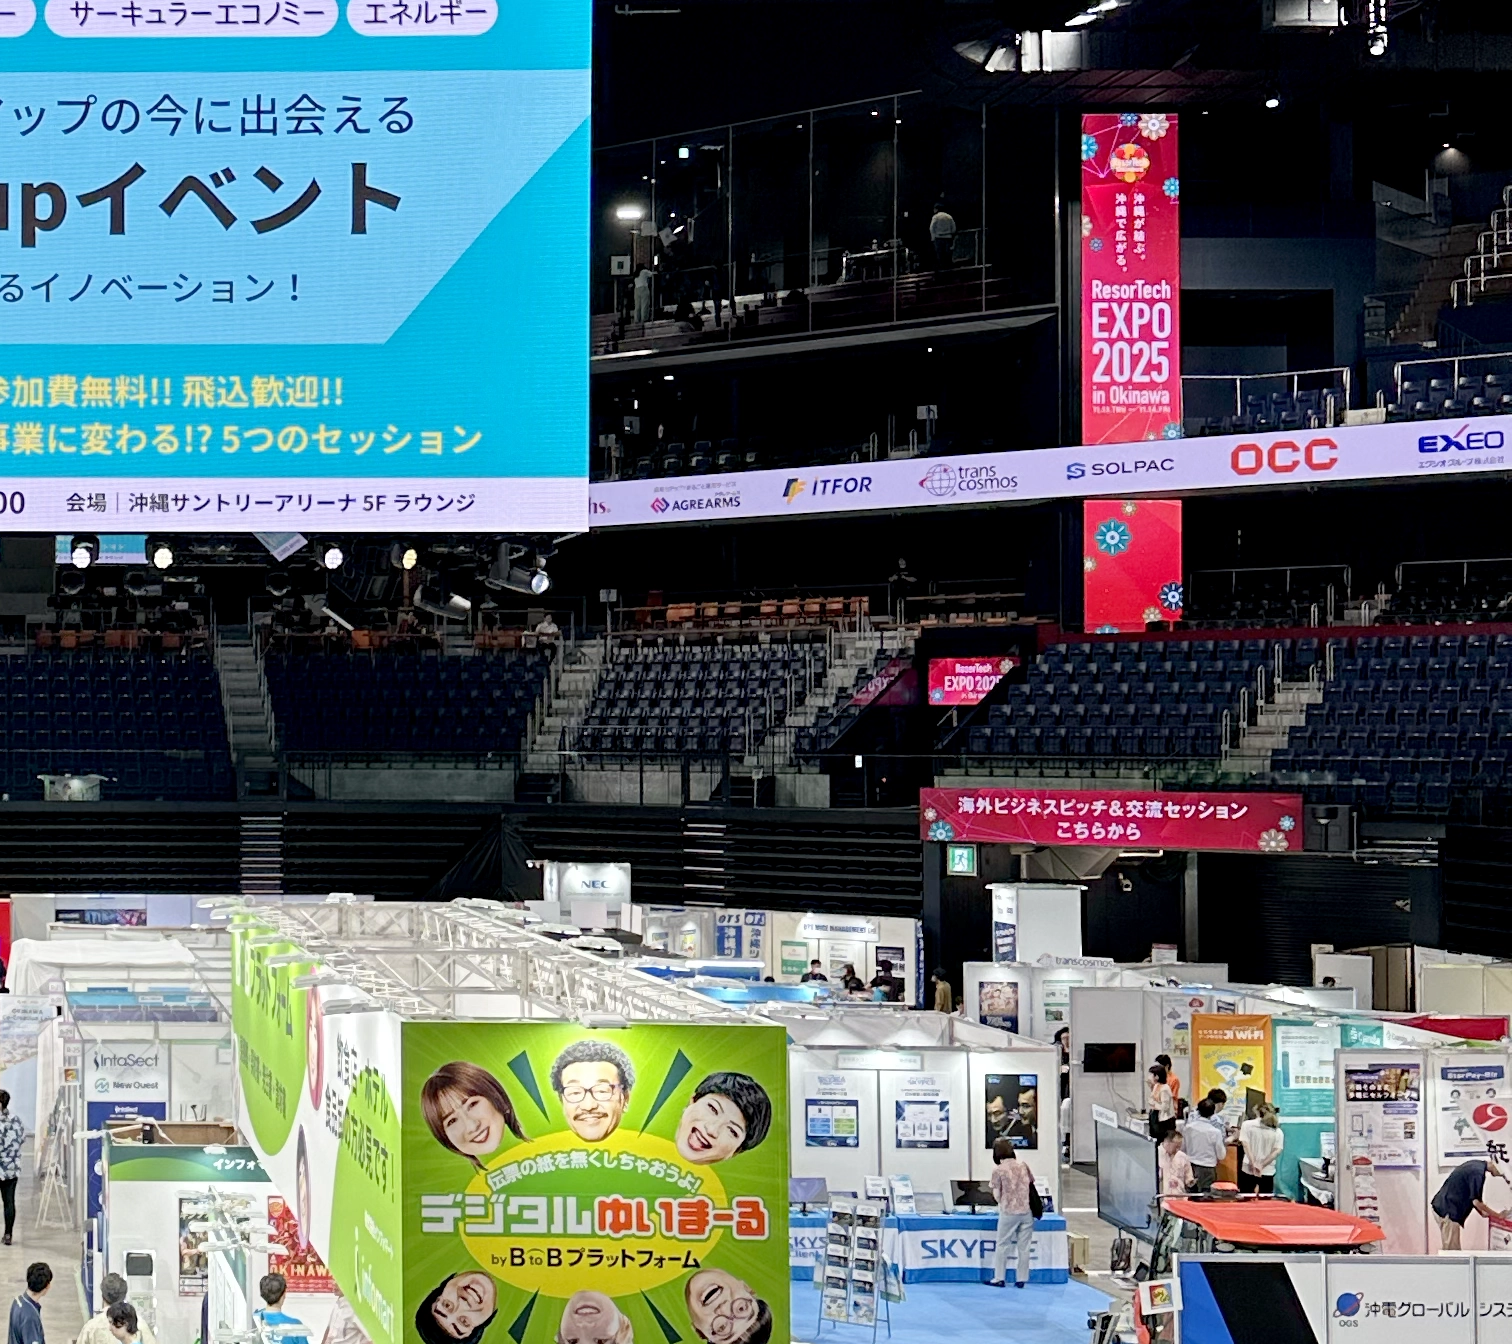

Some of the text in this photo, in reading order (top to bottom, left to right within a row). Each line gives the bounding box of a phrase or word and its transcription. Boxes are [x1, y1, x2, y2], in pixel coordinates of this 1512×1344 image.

[70, 0, 325, 27] サーキュラーエコノミー
[1091, 279, 1171, 300] ResorTech
[1091, 302, 1172, 339] EXPO
[1091, 341, 1170, 383] 2025
[182, 374, 344, 409] 飛込歓迎!!
[1092, 385, 1170, 405] in Okinawa
[222, 423, 483, 456] 5つのセッション
[1418, 424, 1505, 453] EXEO
[1230, 438, 1338, 475] OCC
[958, 465, 996, 479] trans
[1091, 458, 1175, 476] SOLPAC
[958, 475, 1018, 492] cosmos
[65, 492, 476, 513] 会場 沖縄サントリーアリーナ 5F ラウンジ
[672, 496, 741, 512] AGREARMS
[944, 674, 974, 692] EXPO
[1056, 822, 1143, 841] こちらから
[580, 879, 612, 889] NEC
[718, 914, 741, 924] OTS
[1055, 956, 1114, 968] transcosmos
[420, 1192, 770, 1242] デジタルゆいまーる
[491, 1252, 507, 1268] by
[1364, 1301, 1470, 1318] 沖電グローバル
[1338, 1319, 1359, 1328] OGS
